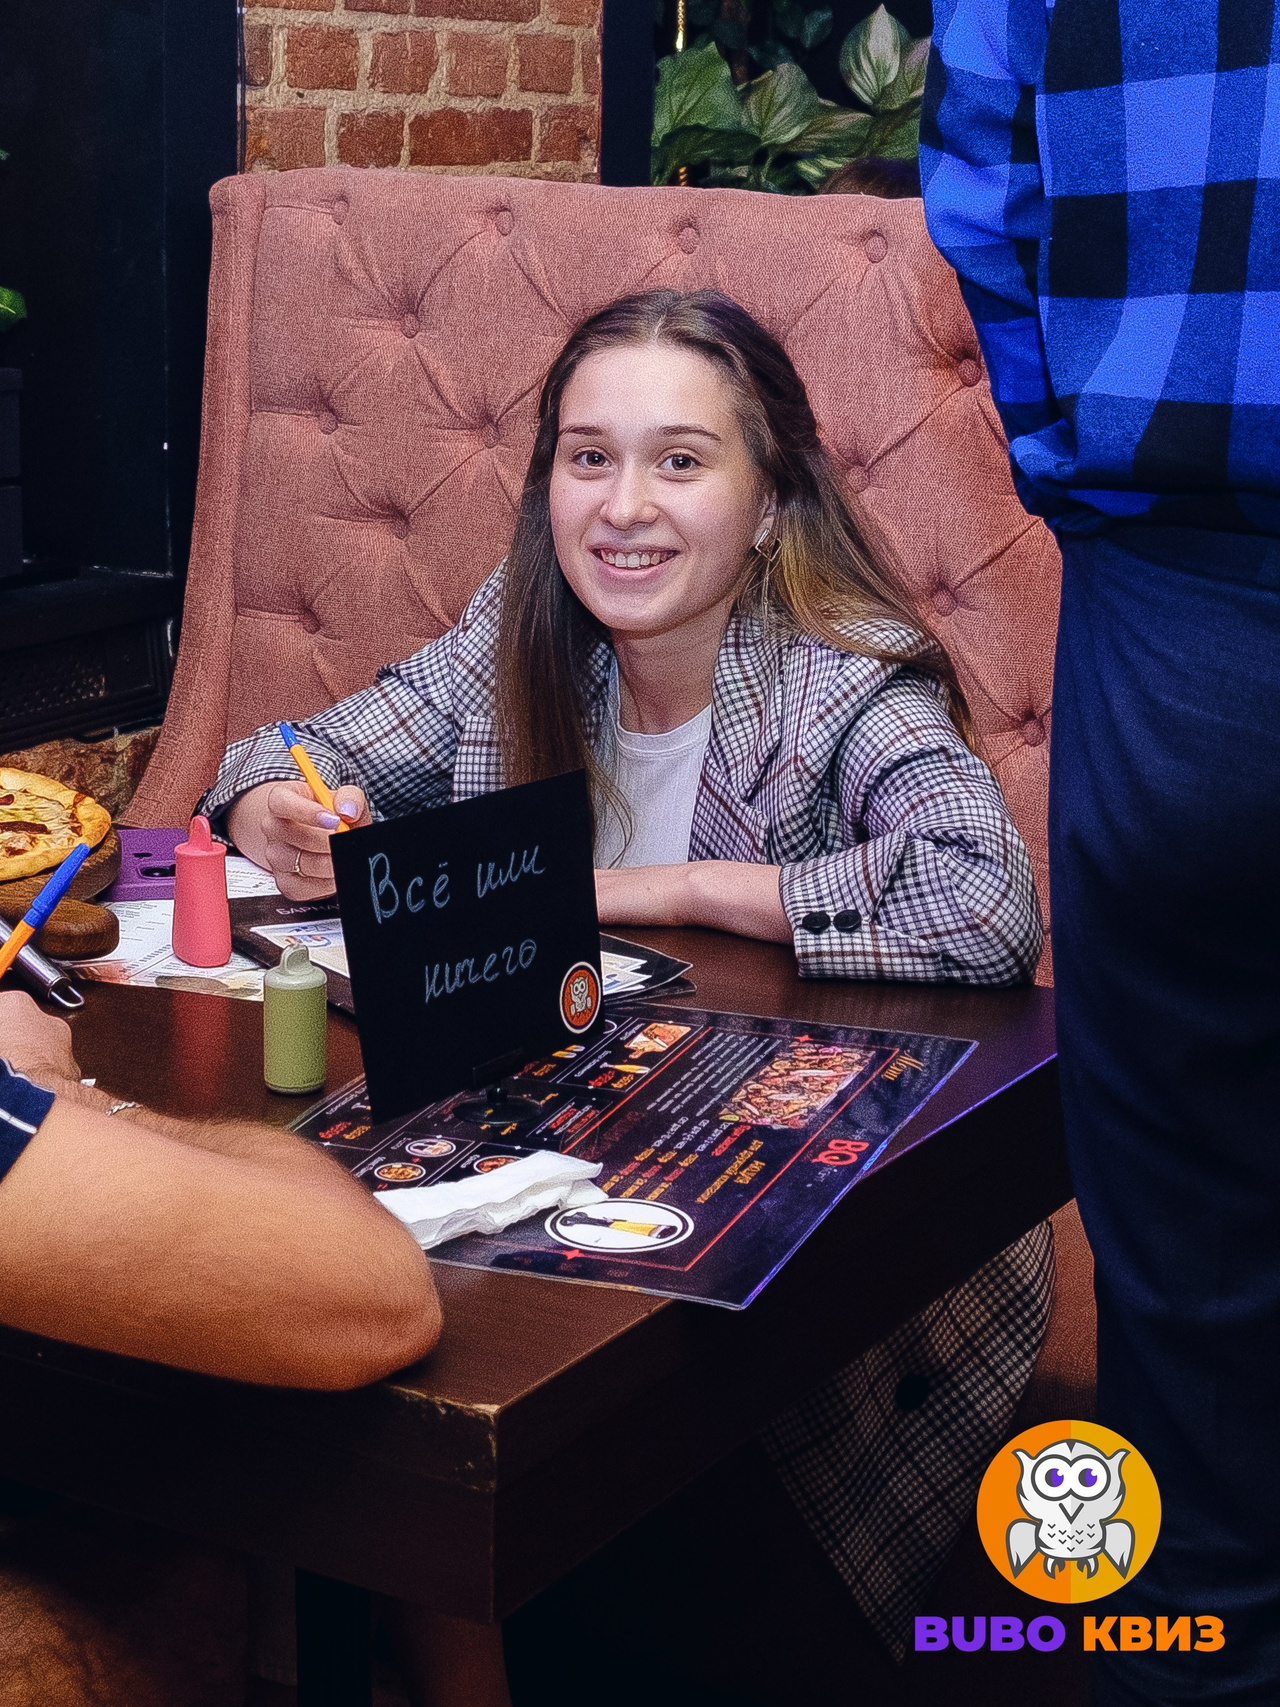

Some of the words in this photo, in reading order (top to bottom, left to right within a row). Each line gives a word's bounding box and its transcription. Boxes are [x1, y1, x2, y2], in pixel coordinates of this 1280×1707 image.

[368, 852, 451, 924] Всё
[477, 845, 546, 898] или
[425, 938, 538, 1003] ничего
[811, 1139, 870, 1166] BQ
